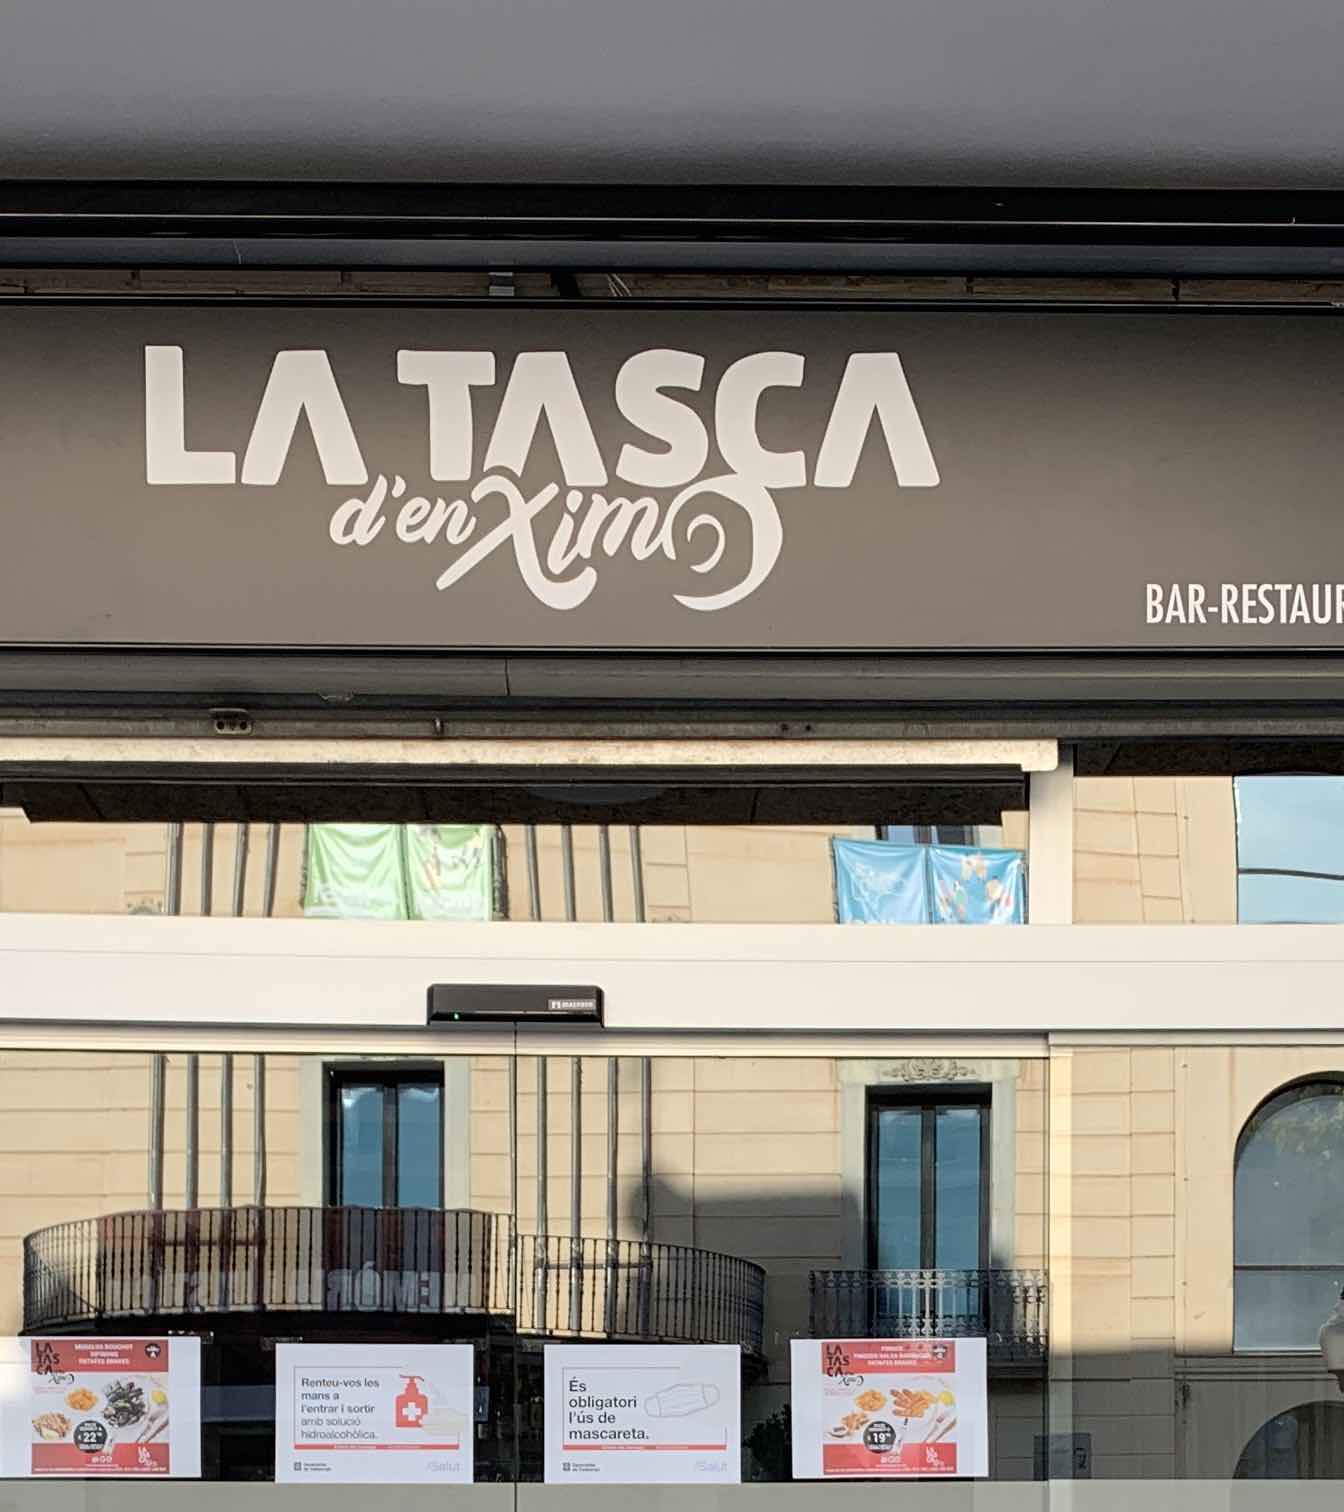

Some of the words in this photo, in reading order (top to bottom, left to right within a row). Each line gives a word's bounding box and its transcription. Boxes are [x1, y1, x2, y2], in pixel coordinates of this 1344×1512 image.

[144, 345, 368, 485] LA
[397, 349, 941, 488] TASCA
[301, 1377, 362, 1388] Renteu-vos
[364, 1377, 380, 1388] les
[568, 1376, 587, 1393] És
[301, 1391, 330, 1401] mans
[333, 1391, 340, 1401] a
[301, 1403, 337, 1413] l'entrar
[347, 1403, 376, 1413] sortir
[568, 1395, 638, 1411] obligatori
[301, 1416, 324, 1426] amb
[568, 1411, 594, 1424] l'ús
[598, 1411, 616, 1424] de
[568, 1428, 650, 1440] mascareta.
